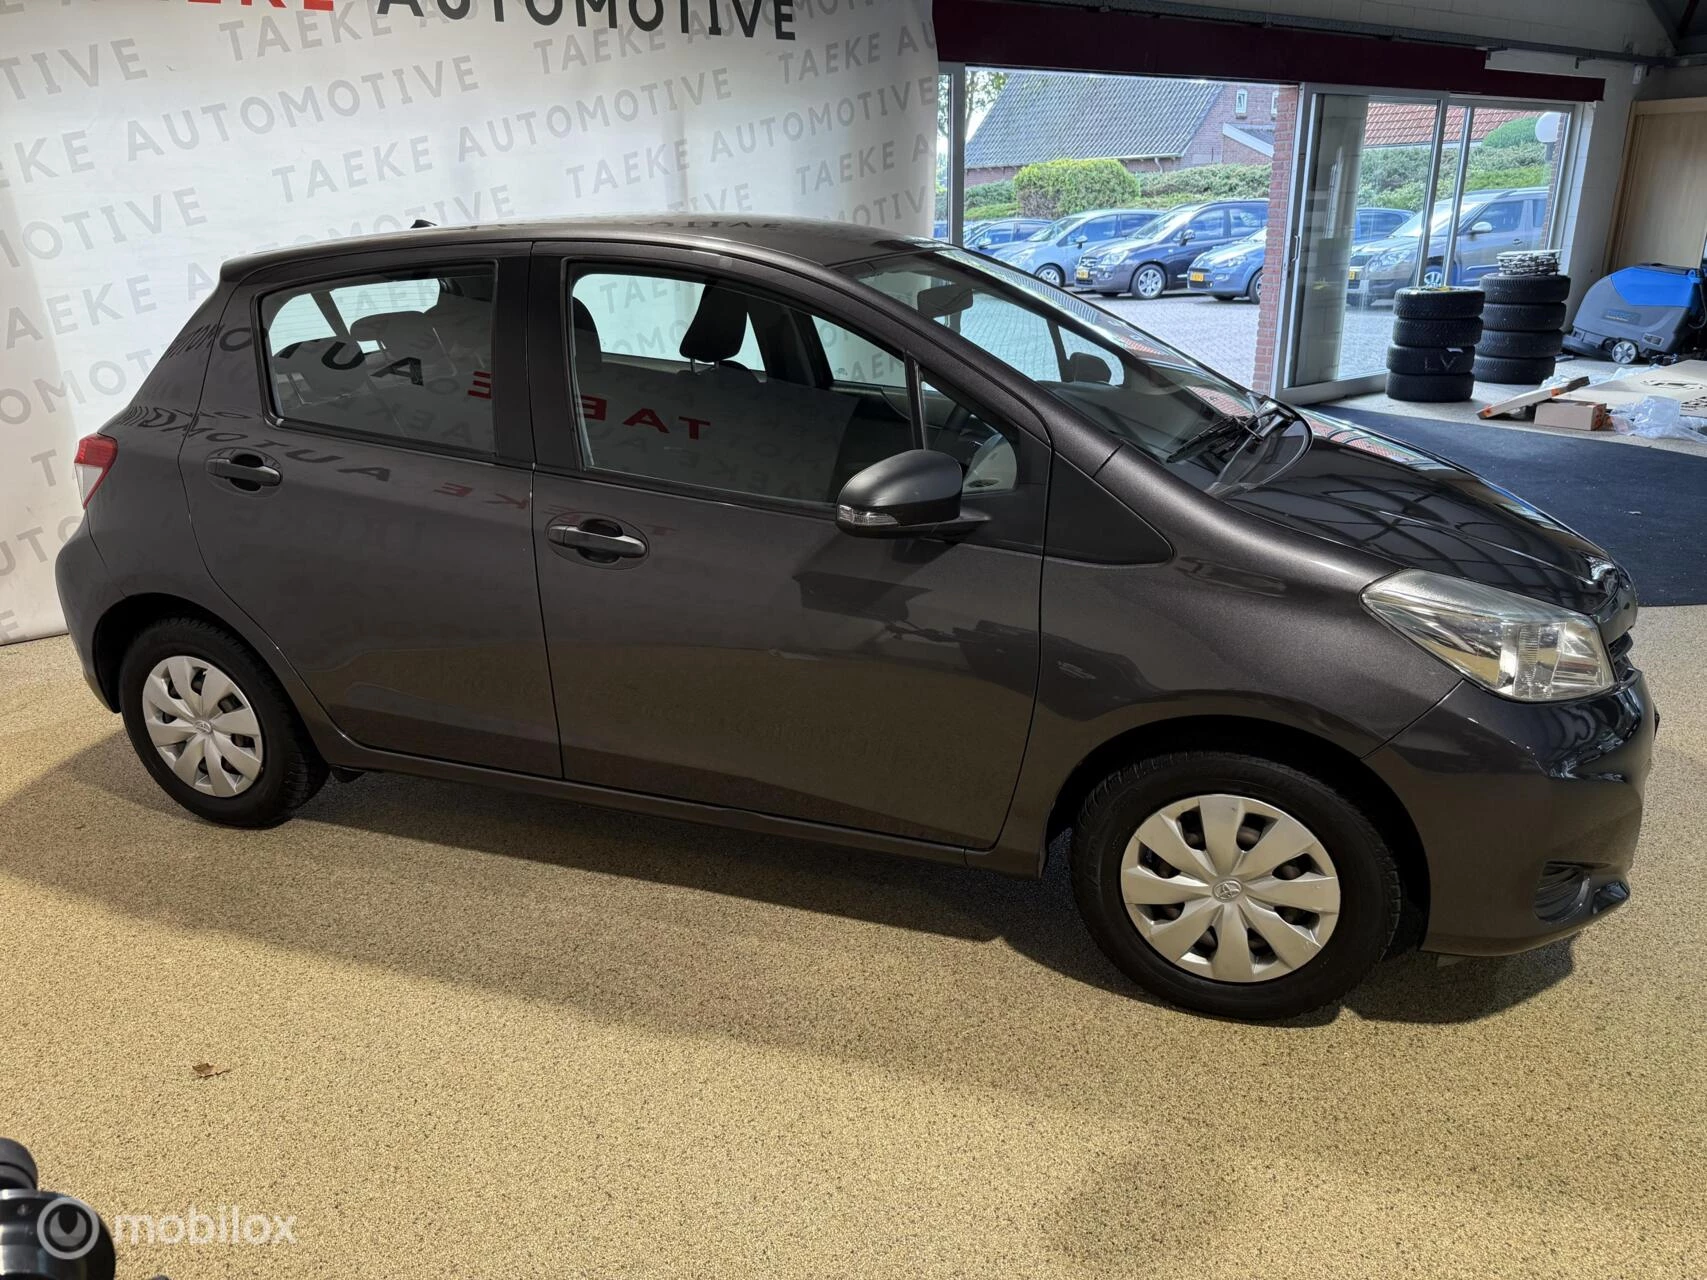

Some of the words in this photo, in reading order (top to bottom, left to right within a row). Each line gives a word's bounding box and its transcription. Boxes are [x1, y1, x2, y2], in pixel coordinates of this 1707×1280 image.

[127, 55, 479, 162] AUTOMOTIVE
[533, 24, 666, 74] TAEKE
[778, 32, 881, 84] TAEKE
[272, 136, 434, 202] TAEKE
[458, 68, 732, 162] AUTOMOTIVE
[566, 140, 690, 198] TAEKE
[710, 77, 937, 162] AUTOMOTIVE
[796, 140, 895, 195] TAEKE
